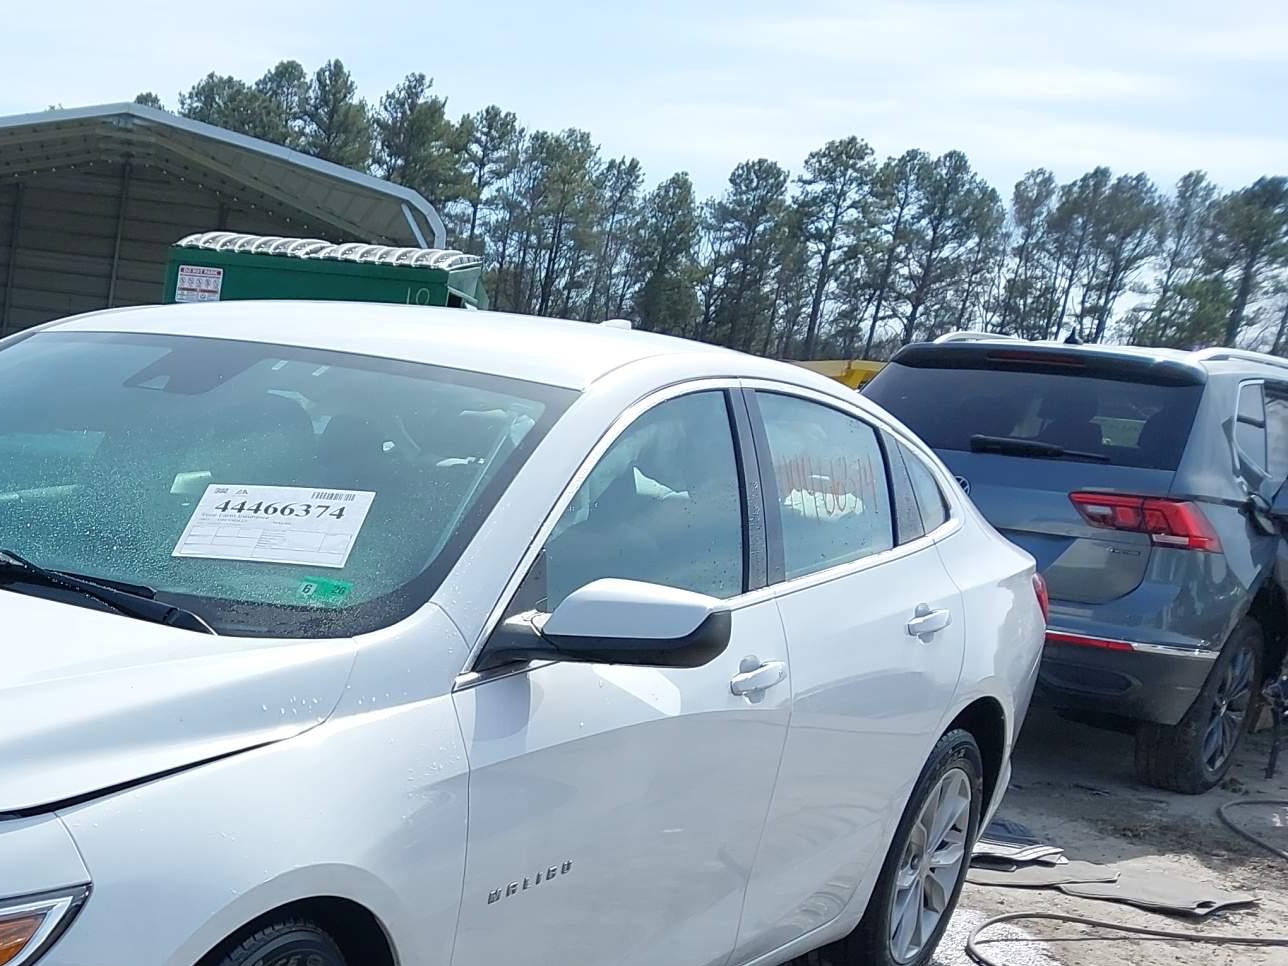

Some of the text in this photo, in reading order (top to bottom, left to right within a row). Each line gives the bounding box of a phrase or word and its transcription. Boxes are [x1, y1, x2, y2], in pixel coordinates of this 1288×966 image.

[214, 499, 346, 520] 44466374
[302, 584, 313, 594] 6
[488, 860, 573, 904] MALIBU
